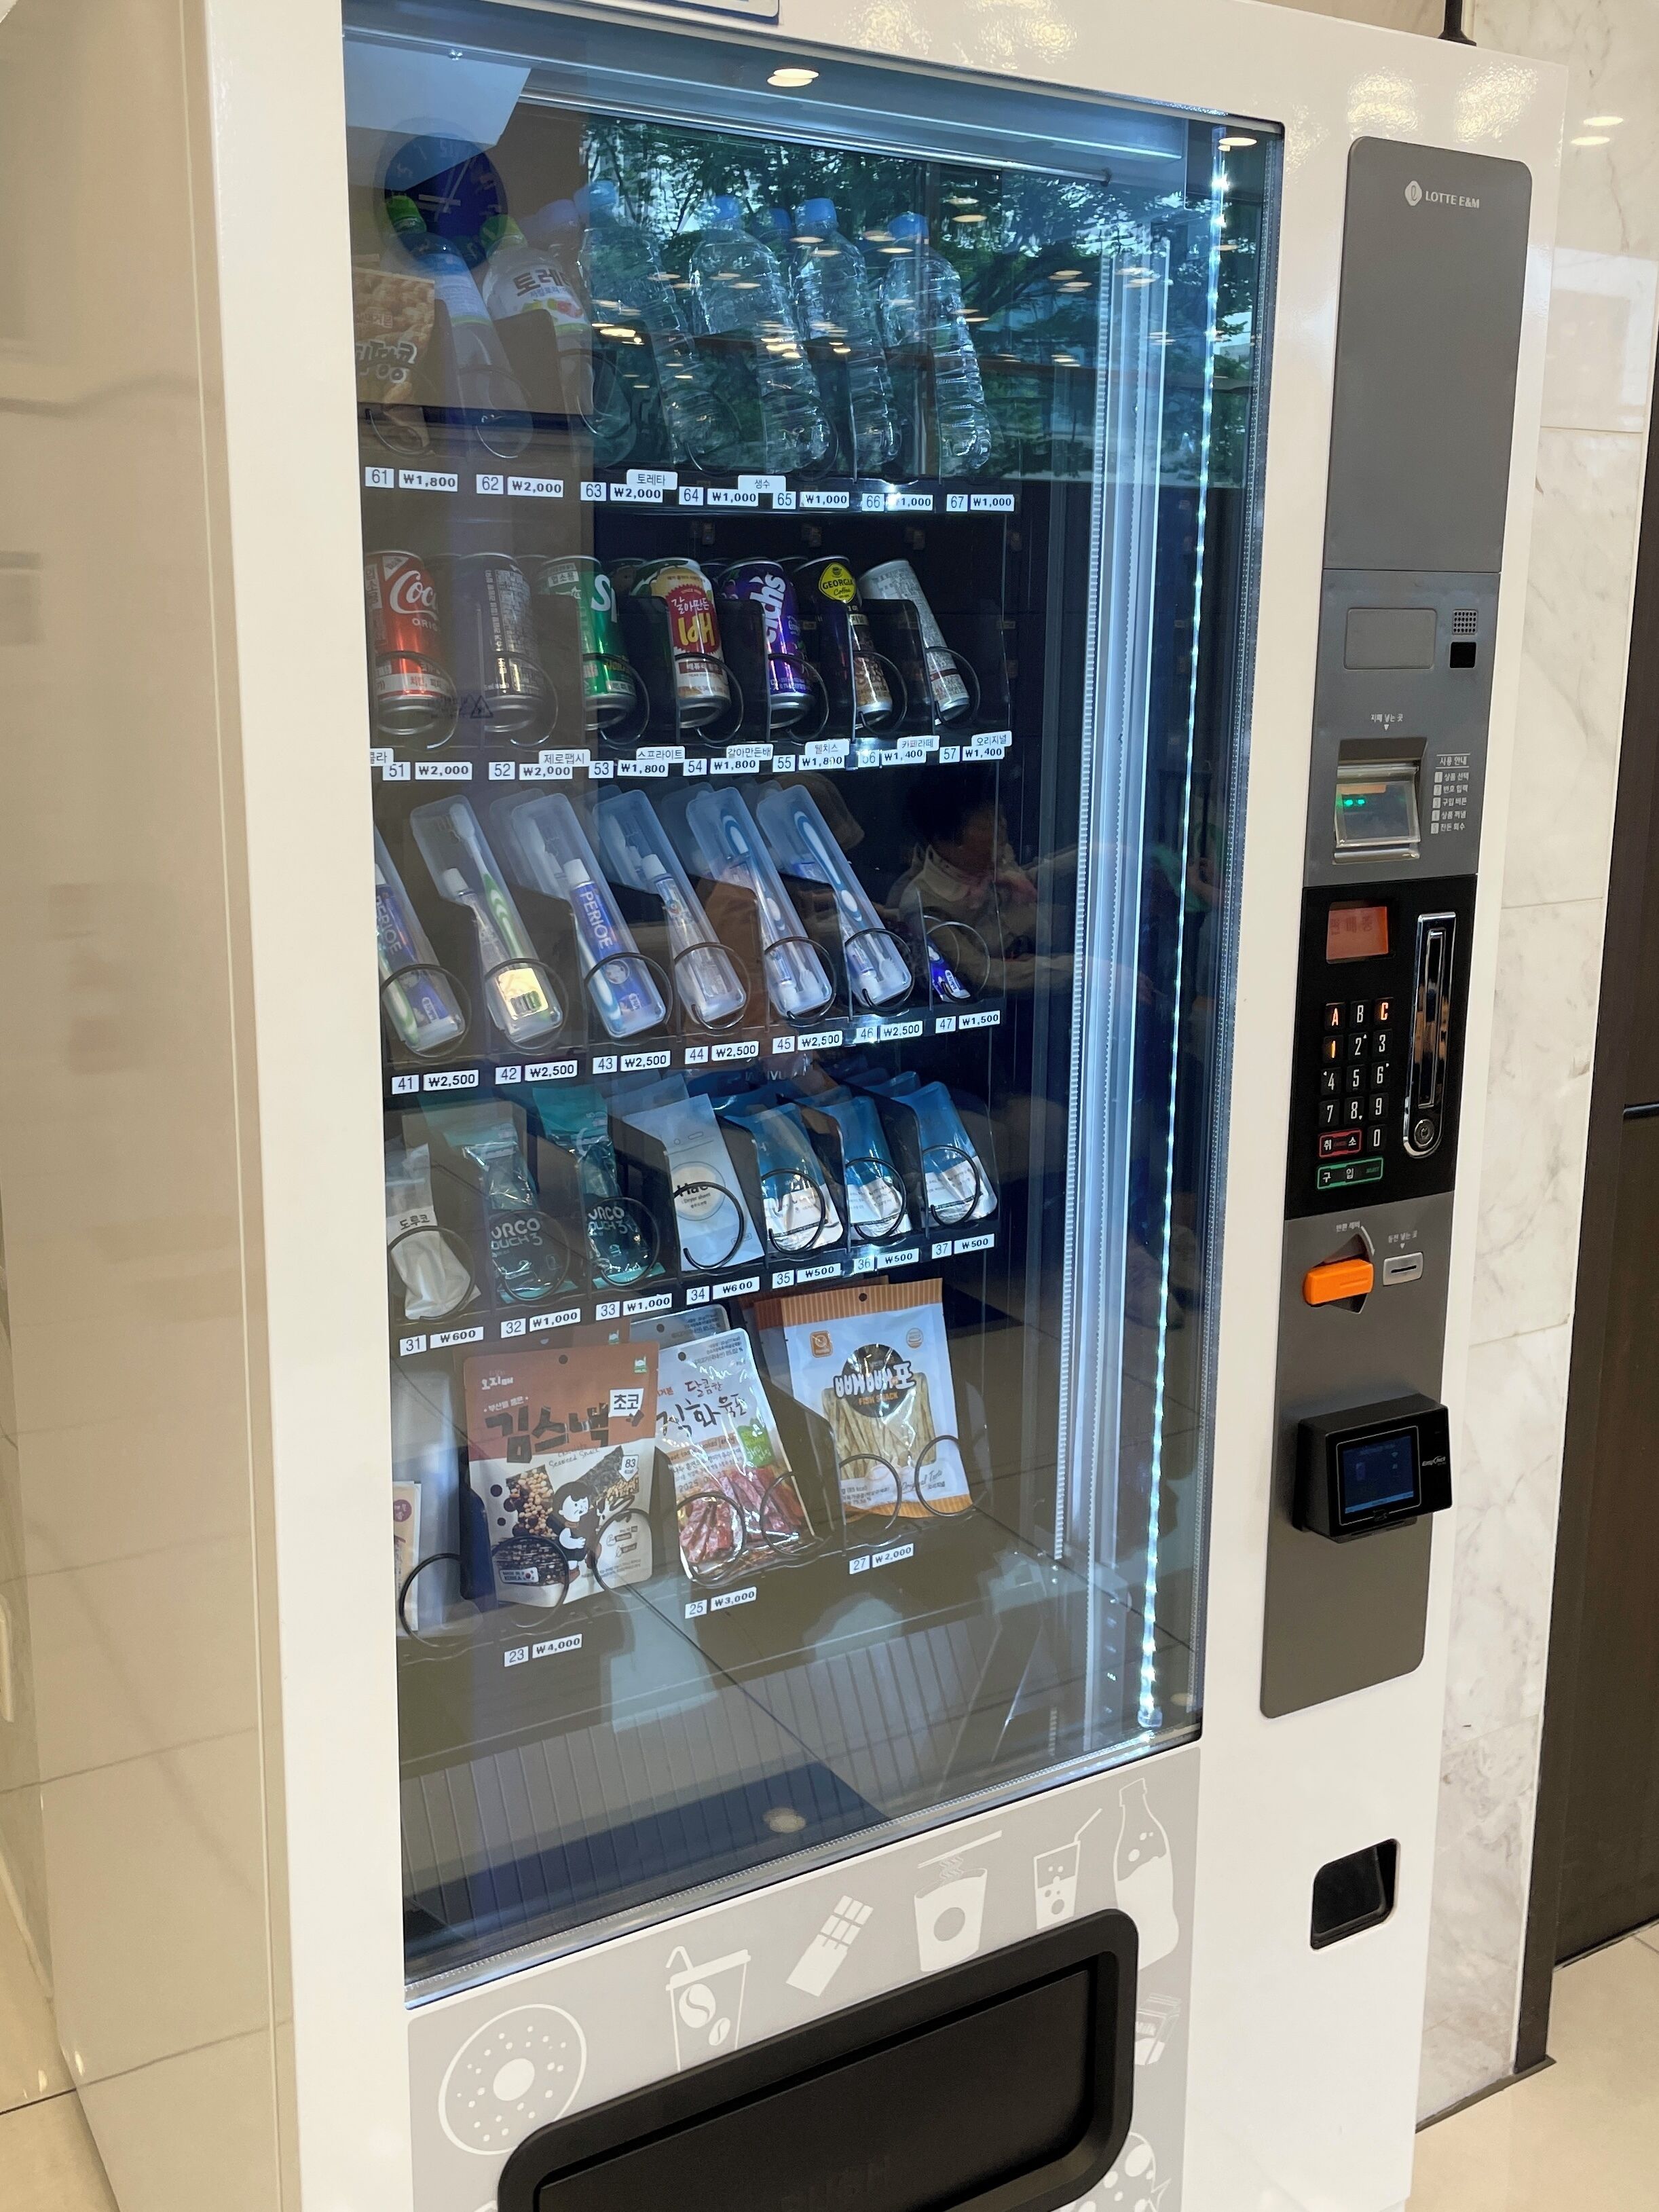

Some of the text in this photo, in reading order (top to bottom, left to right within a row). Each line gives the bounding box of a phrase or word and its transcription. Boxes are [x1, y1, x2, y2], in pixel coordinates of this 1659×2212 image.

[1425, 190, 1480, 208] LOTTE E&M
[372, 469, 388, 485] 61
[403, 474, 455, 488] ₩1,800
[637, 474, 666, 486] 토레타
[754, 478, 770, 490] 생수
[482, 477, 499, 492] 62
[512, 480, 562, 494] ₩2,000
[586, 483, 601, 498] 63
[614, 488, 661, 500] ₩2,000
[684, 490, 698, 502] 64
[713, 492, 757, 504] ₩1,000
[777, 492, 792, 506] 65
[806, 494, 847, 504] ₩1,000
[866, 496, 880, 509] 66
[894, 497, 931, 508] 1,000
[950, 496, 965, 509] 67
[973, 496, 1011, 507] ₩1,000
[822, 578, 854, 589] GEORGIA
[671, 596, 710, 614] 갈아만든
[1371, 714, 1383, 722] 지폐
[901, 737, 934, 749] 카페라떼
[977, 733, 1007, 746] 오리지널
[637, 748, 683, 761] 스프라이트
[728, 746, 772, 758] 갈아만든배
[884, 749, 922, 762] ₩1,400
[944, 748, 956, 760] 57
[965, 747, 1002, 758] ₩1,400
[594, 761, 610, 775] 53
[621, 762, 665, 775] ₩1,800
[688, 760, 703, 773] 54
[714, 759, 756, 771] ₩1,800
[777, 756, 791, 769] 55
[1440, 756, 1468, 767] 사용 안내
[389, 762, 405, 778] 51
[418, 764, 469, 776] ₩2,000
[494, 762, 510, 777] 52
[523, 767, 570, 777] ₩2,000
[1444, 773, 1456, 781] 상품
[1457, 772, 1470, 781] 선택
[1442, 798, 1454, 807] 구입
[1441, 811, 1453, 820] 상품
[580, 891, 614, 951] PERIOE
[1331, 1008, 1339, 1027] A
[1356, 1004, 1364, 1023] B
[1380, 1002, 1389, 1020] C
[940, 1018, 952, 1030] 47
[962, 1014, 999, 1027] ₩1,500
[861, 1027, 874, 1040] 46
[883, 1023, 920, 1037] ₩2,500
[777, 1037, 791, 1050] 45
[802, 1033, 840, 1048] ₩2,500
[1354, 1037, 1362, 1056] 2
[1379, 1034, 1386, 1052] 3
[690, 1048, 704, 1061] 44
[715, 1044, 756, 1058] ₩2,500
[1331, 1040, 1336, 1058] 1
[597, 1057, 614, 1071] 43
[625, 1054, 667, 1068] ₩2,500
[501, 1067, 517, 1081] 42
[529, 1065, 574, 1078] ₩2,500
[1352, 1069, 1360, 1087] 5
[1377, 1066, 1384, 1084] 6
[398, 1077, 413, 1091] 41
[428, 1073, 475, 1088] ₩2,500
[1328, 1073, 1335, 1090] 4
[1326, 1104, 1334, 1123] 7
[1350, 1101, 1358, 1120] 8
[1375, 1097, 1383, 1116] 9
[1373, 1128, 1381, 1147] 0
[399, 1214, 430, 1230] 도루코
[491, 1232, 543, 1251] OUCH 3
[962, 1238, 990, 1251] ₩500
[935, 1243, 948, 1255] 37
[858, 1257, 872, 1270] 36
[884, 1252, 913, 1265] ₩500
[777, 1272, 791, 1285] 35
[805, 1265, 834, 1278] ₩500
[722, 1280, 753, 1295] ₩600
[690, 1288, 705, 1302] 34
[600, 1304, 616, 1317] 33
[627, 1297, 671, 1312] ₩1,000
[532, 1312, 578, 1328] ₩1,000
[506, 1321, 521, 1335] 32
[439, 1329, 476, 1344] ₩600
[405, 1338, 421, 1353] 31
[684, 1378, 724, 1399] 달콤한
[613, 1393, 639, 1411] 초코
[858, 1395, 876, 1406] FISH
[485, 1401, 610, 1464] 김스낵
[625, 1458, 637, 1469] 83
[875, 1547, 912, 1564] ₩2,000
[853, 1557, 866, 1571] 27
[714, 1591, 755, 1607] ₩3,000
[689, 1602, 704, 1616] 25
[536, 1636, 581, 1655] ₩4,000
[508, 1648, 525, 1663] 23
